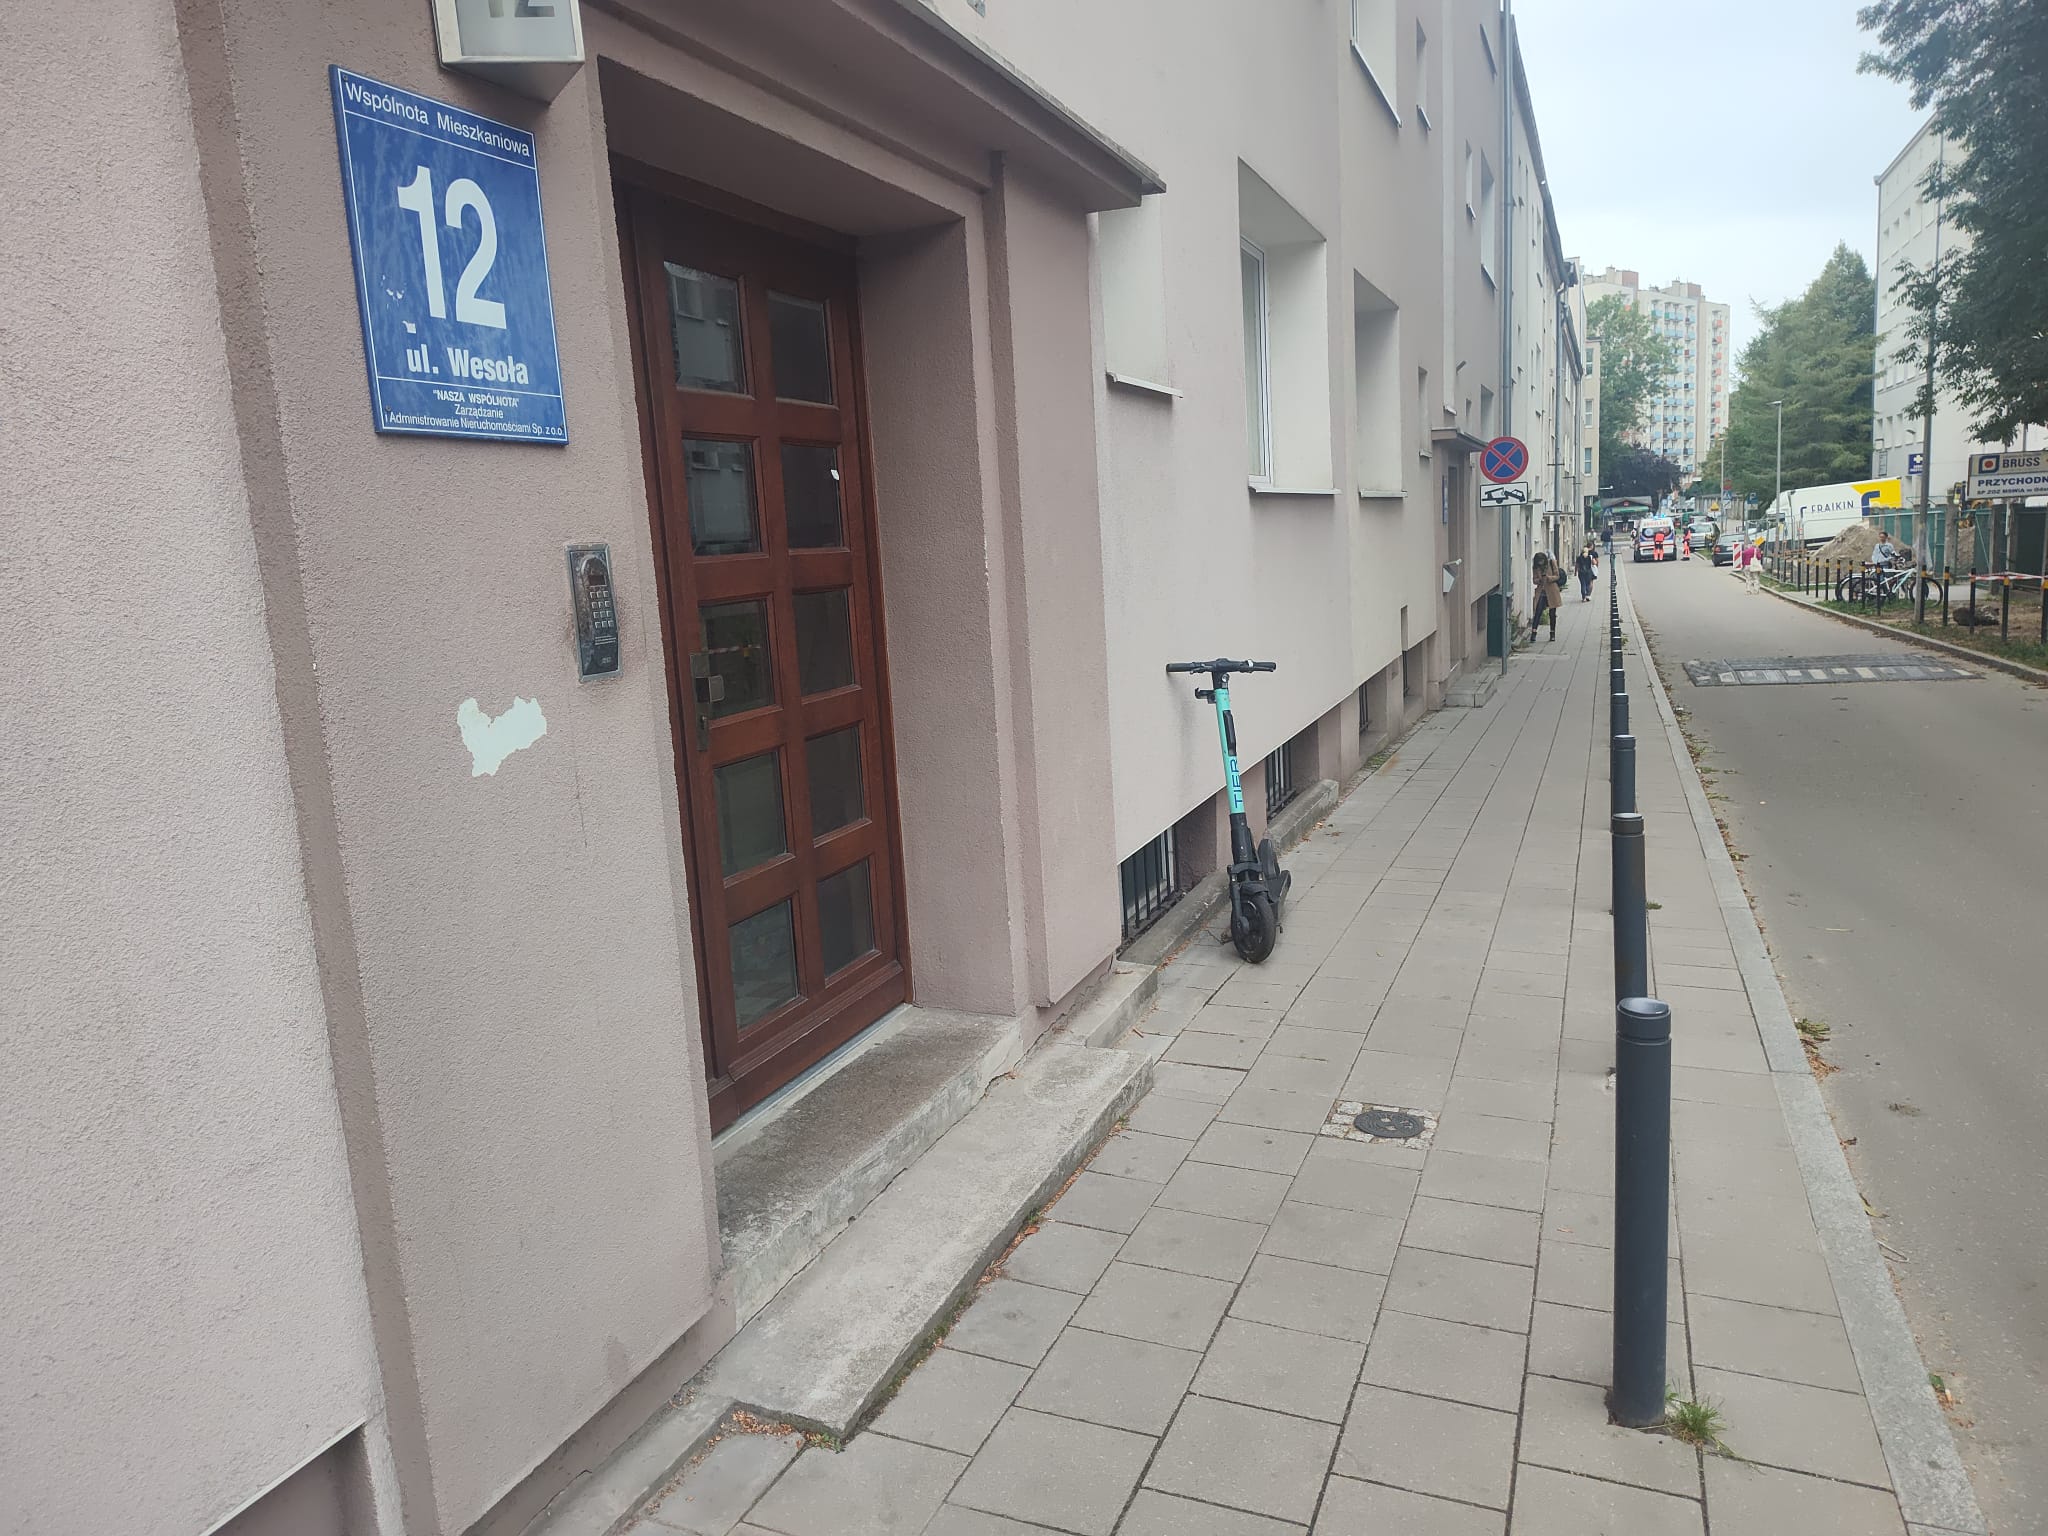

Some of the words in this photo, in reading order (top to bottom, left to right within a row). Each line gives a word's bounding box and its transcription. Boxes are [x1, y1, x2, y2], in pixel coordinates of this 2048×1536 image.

[345, 81, 429, 125] Wspólnota
[436, 112, 530, 157] Mieszkaniowa
[397, 165, 507, 329] 12
[406, 344, 439, 374] ul.
[447, 347, 529, 385] Wesoła
[389, 411, 459, 428] Administrowanie
[461, 417, 532, 433] Nieruchomościami
[454, 403, 504, 419] Zarządzanie
[2002, 456, 2041, 469] BRUSS
[1811, 500, 1854, 513] FRAIKIN
[1230, 759, 1243, 809] TIER
